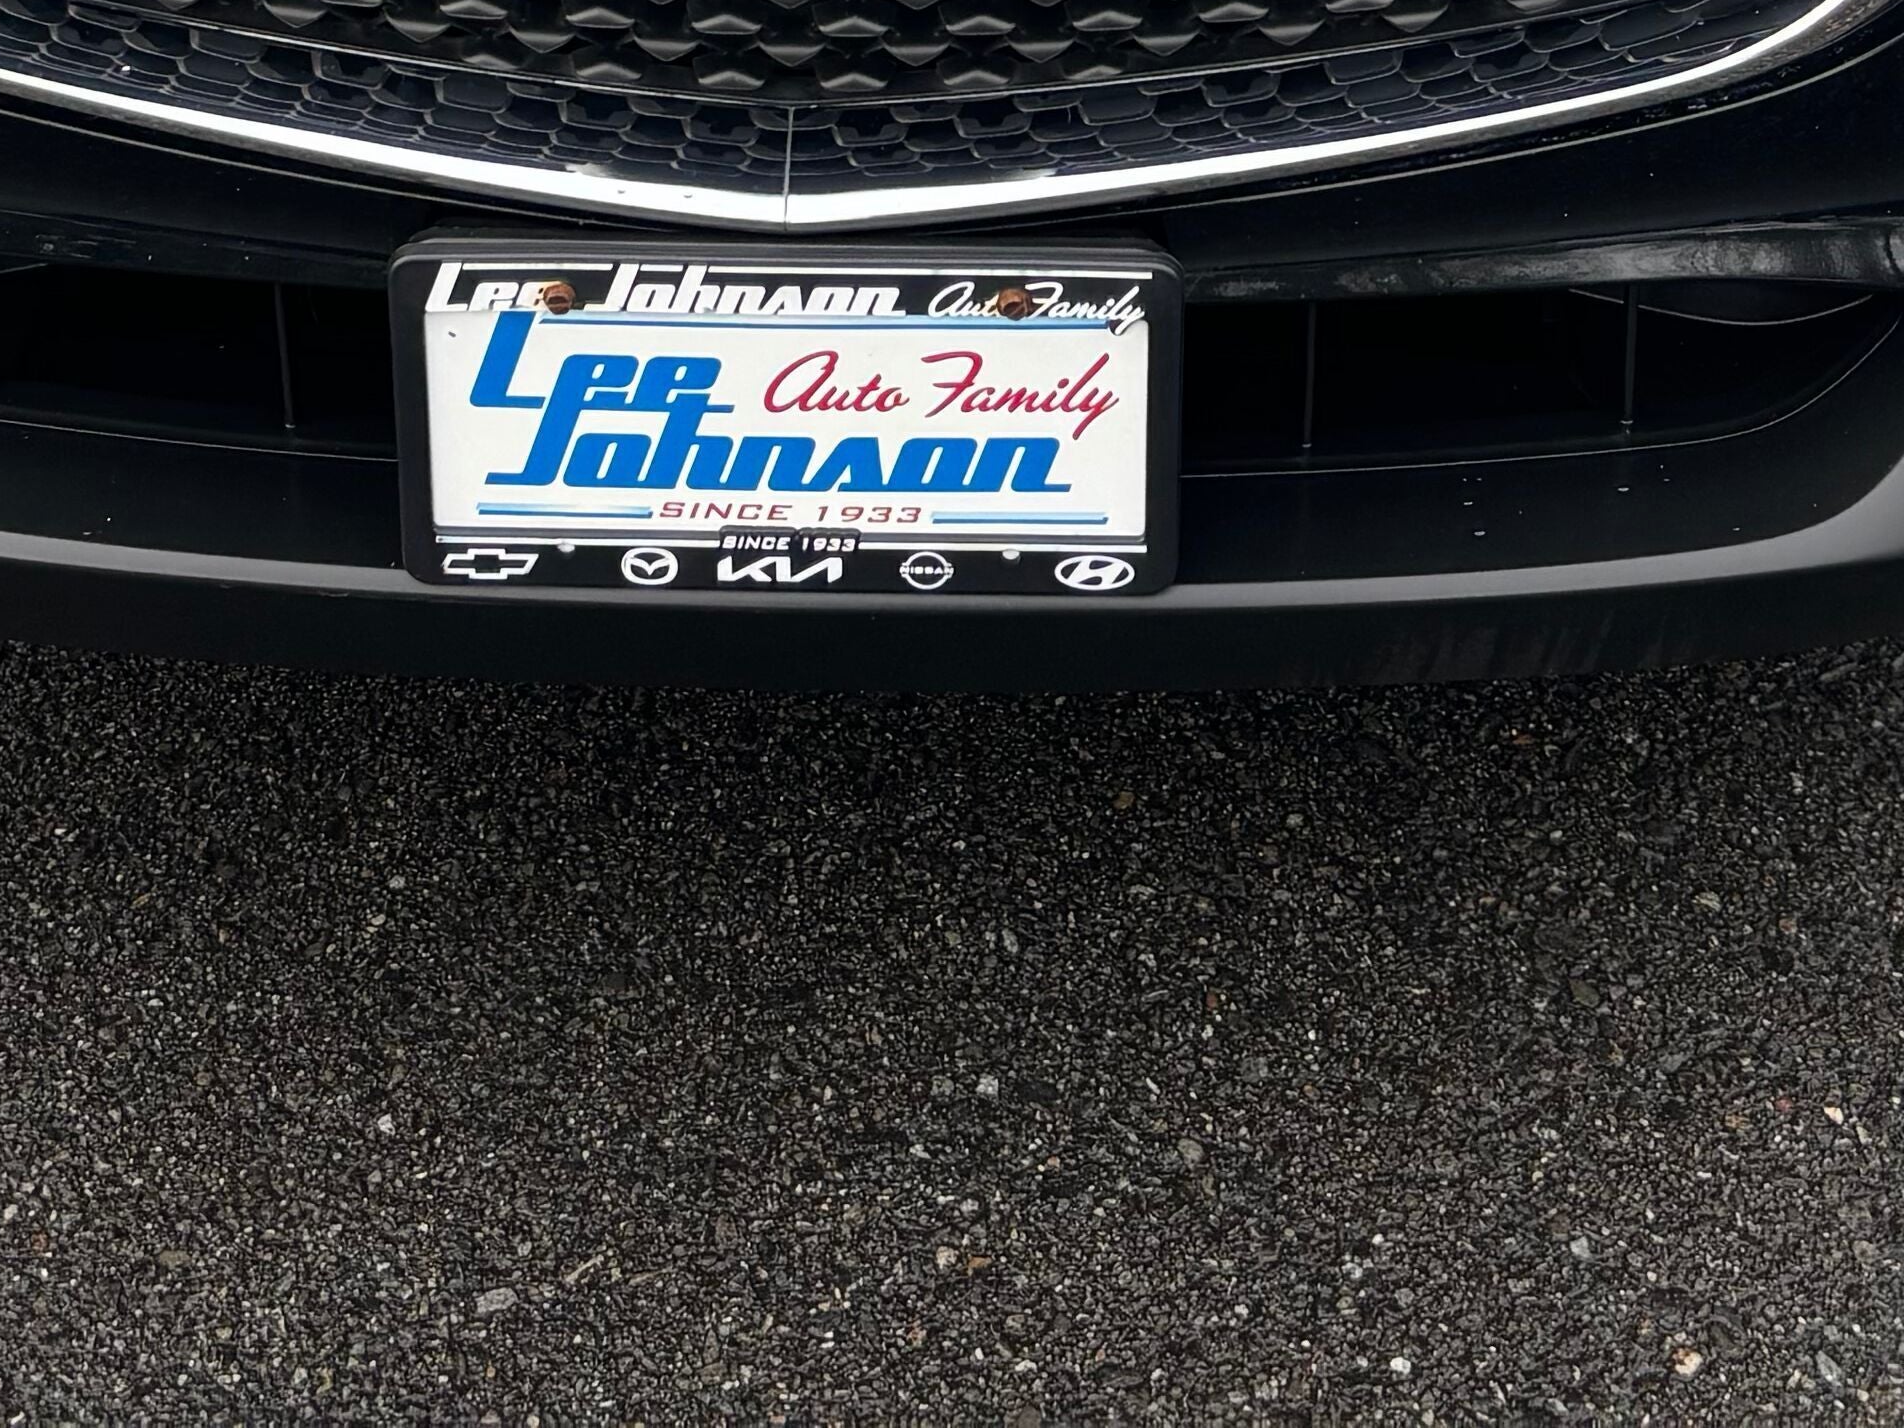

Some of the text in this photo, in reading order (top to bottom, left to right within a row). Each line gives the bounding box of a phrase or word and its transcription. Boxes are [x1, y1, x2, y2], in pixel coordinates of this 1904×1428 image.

[584, 263, 907, 317] Johnson
[1024, 282, 1146, 336] Family
[469, 311, 1121, 440] Lee Auto Family
[484, 404, 1072, 493] Johnson
[659, 501, 923, 524] SINCE 1933
[721, 535, 857, 553] SINCE 1933
